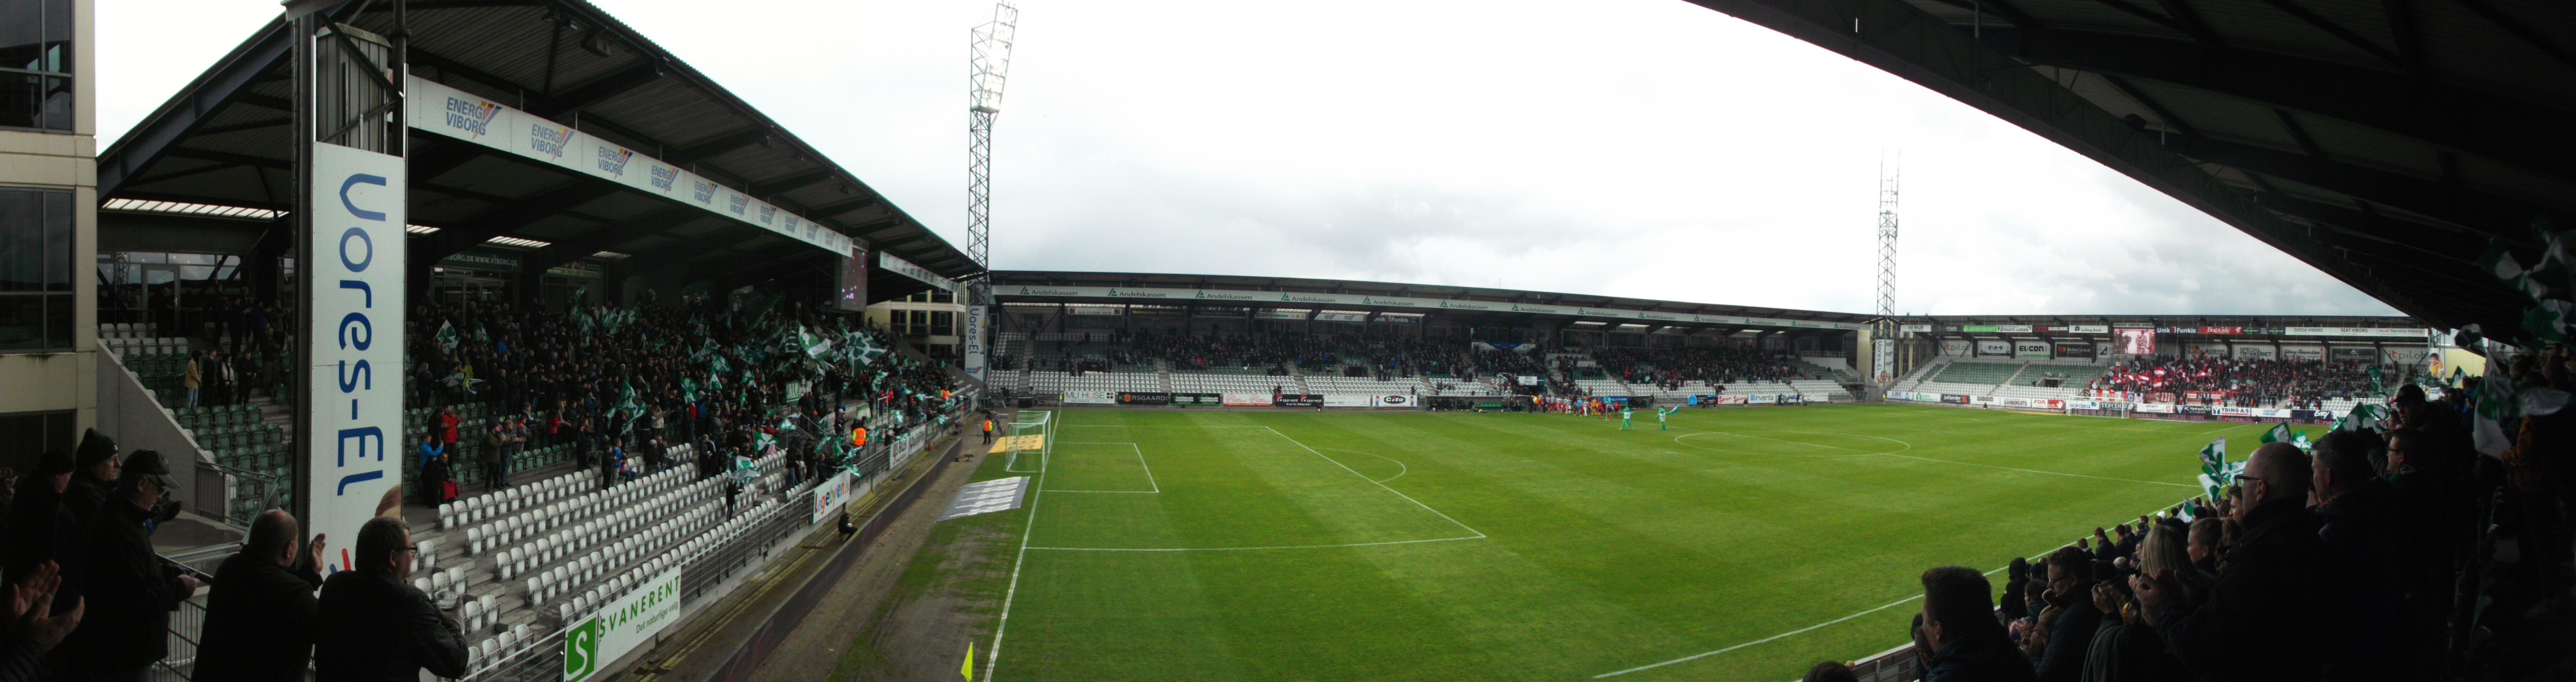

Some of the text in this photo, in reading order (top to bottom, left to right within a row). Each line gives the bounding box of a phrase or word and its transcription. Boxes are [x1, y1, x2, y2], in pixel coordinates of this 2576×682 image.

[447, 97, 486, 120] ENERGI
[446, 112, 486, 136] VIBORG
[532, 123, 563, 142] ENERGI
[531, 137, 563, 158] VIBORG
[598, 146, 623, 163] ENERGI
[598, 158, 623, 176] VIBORG
[651, 165, 671, 180] ENERGI
[651, 176, 672, 191] VIBORG
[695, 181, 710, 194] ENERGI
[694, 191, 711, 205] VIBORG
[2388, 350, 2425, 360] itpilot
[599, 576, 680, 638] SVANERENT
[636, 601, 678, 634] Det naturlige valg
